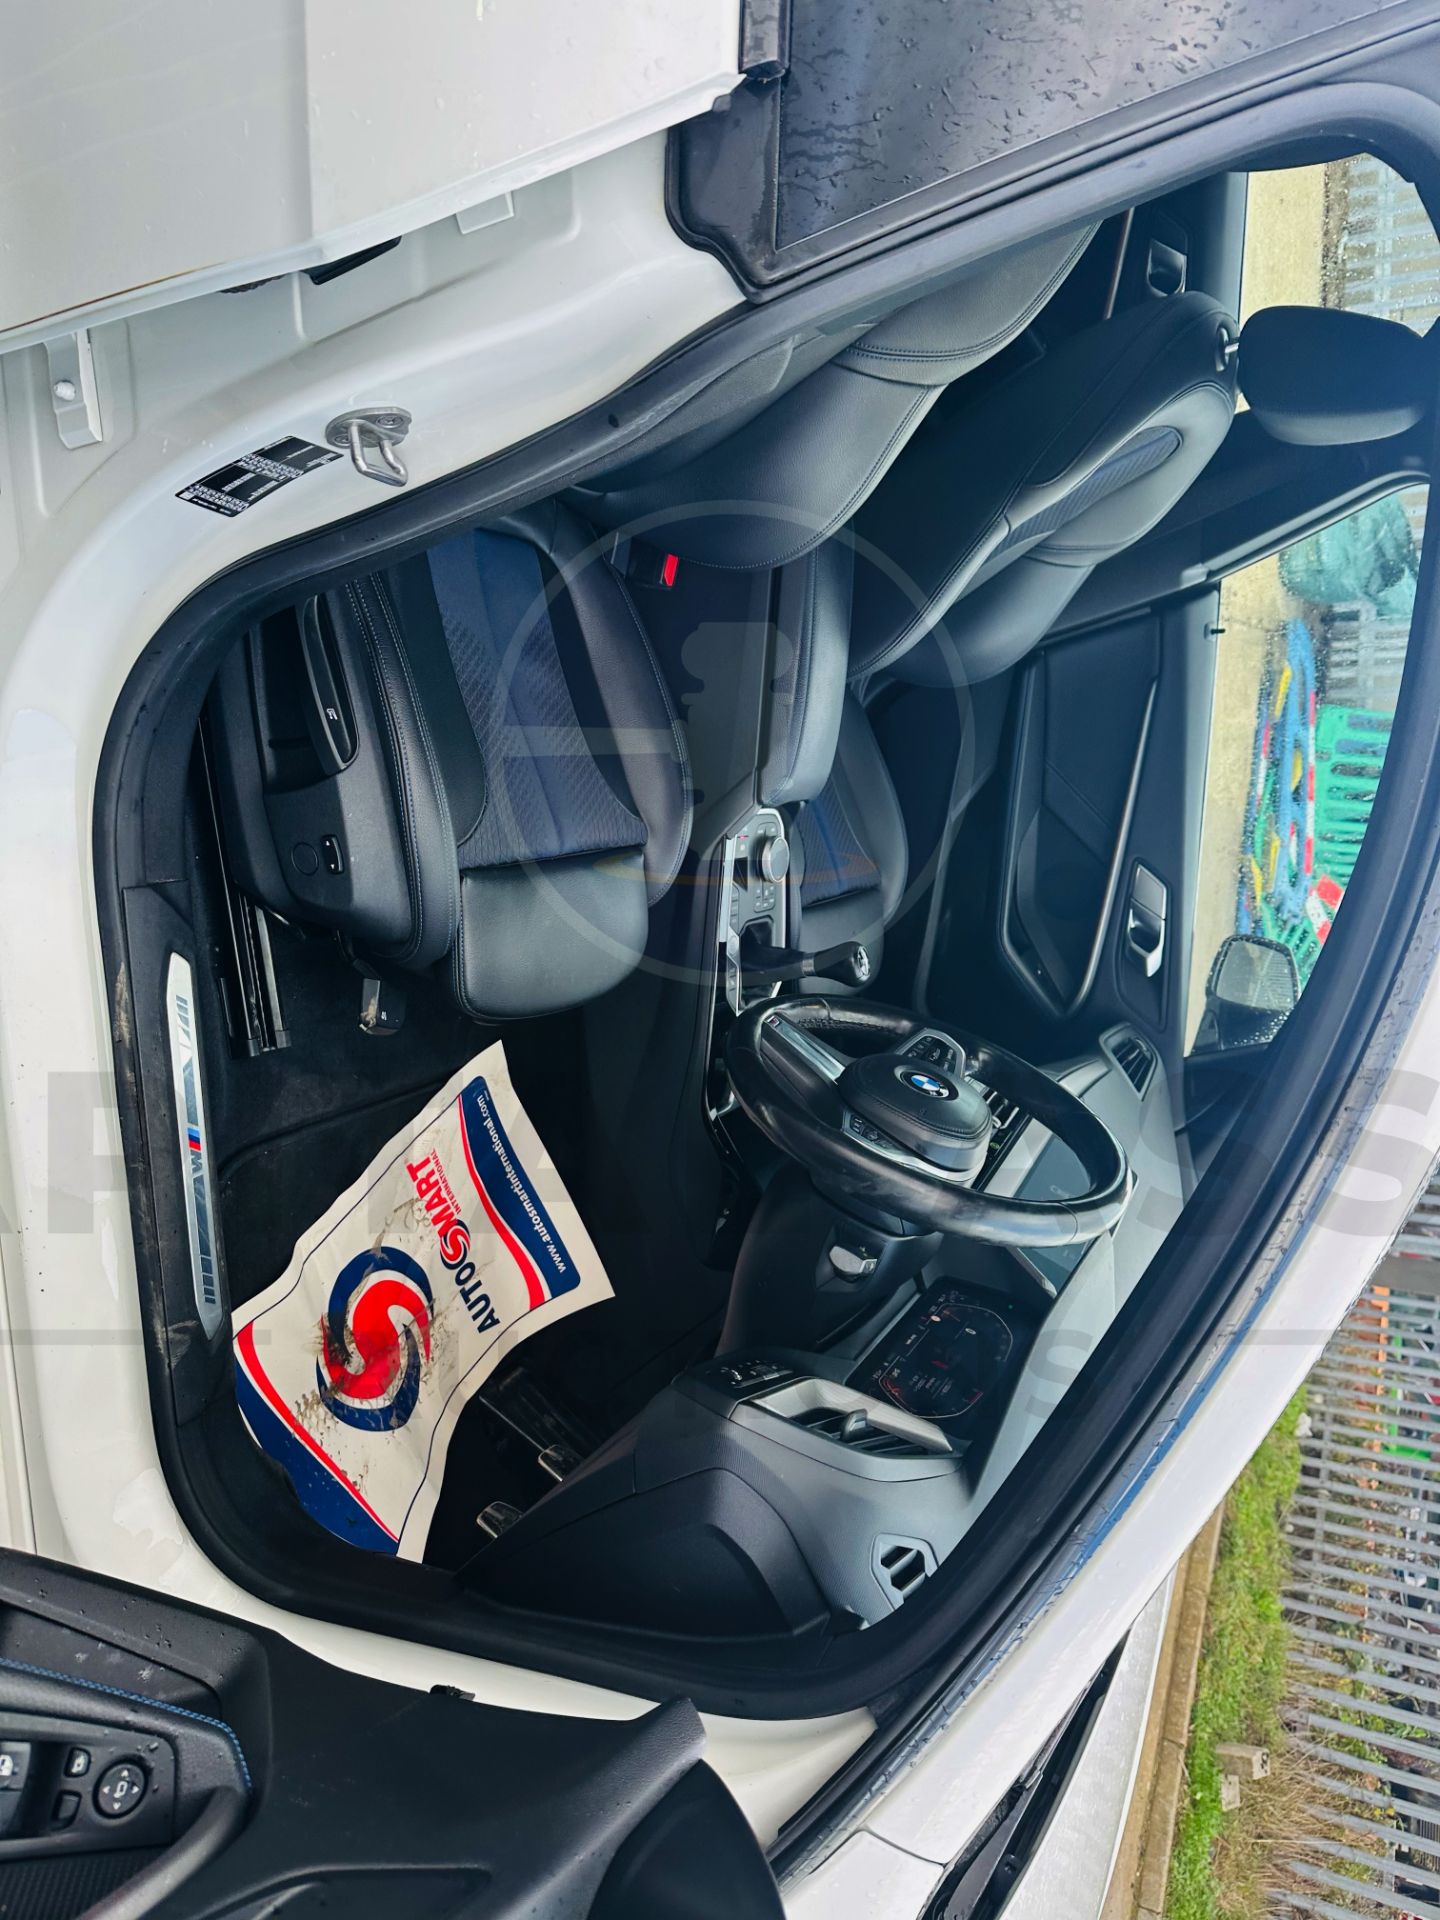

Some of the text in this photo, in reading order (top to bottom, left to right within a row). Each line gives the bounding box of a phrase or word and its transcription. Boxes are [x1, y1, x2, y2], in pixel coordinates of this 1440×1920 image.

[406, 1156, 501, 1334] AUTOSMART
[431, 1148, 462, 1214] INTERNATIONAL
[477, 1095, 567, 1274] www.autosmartinternational.com
